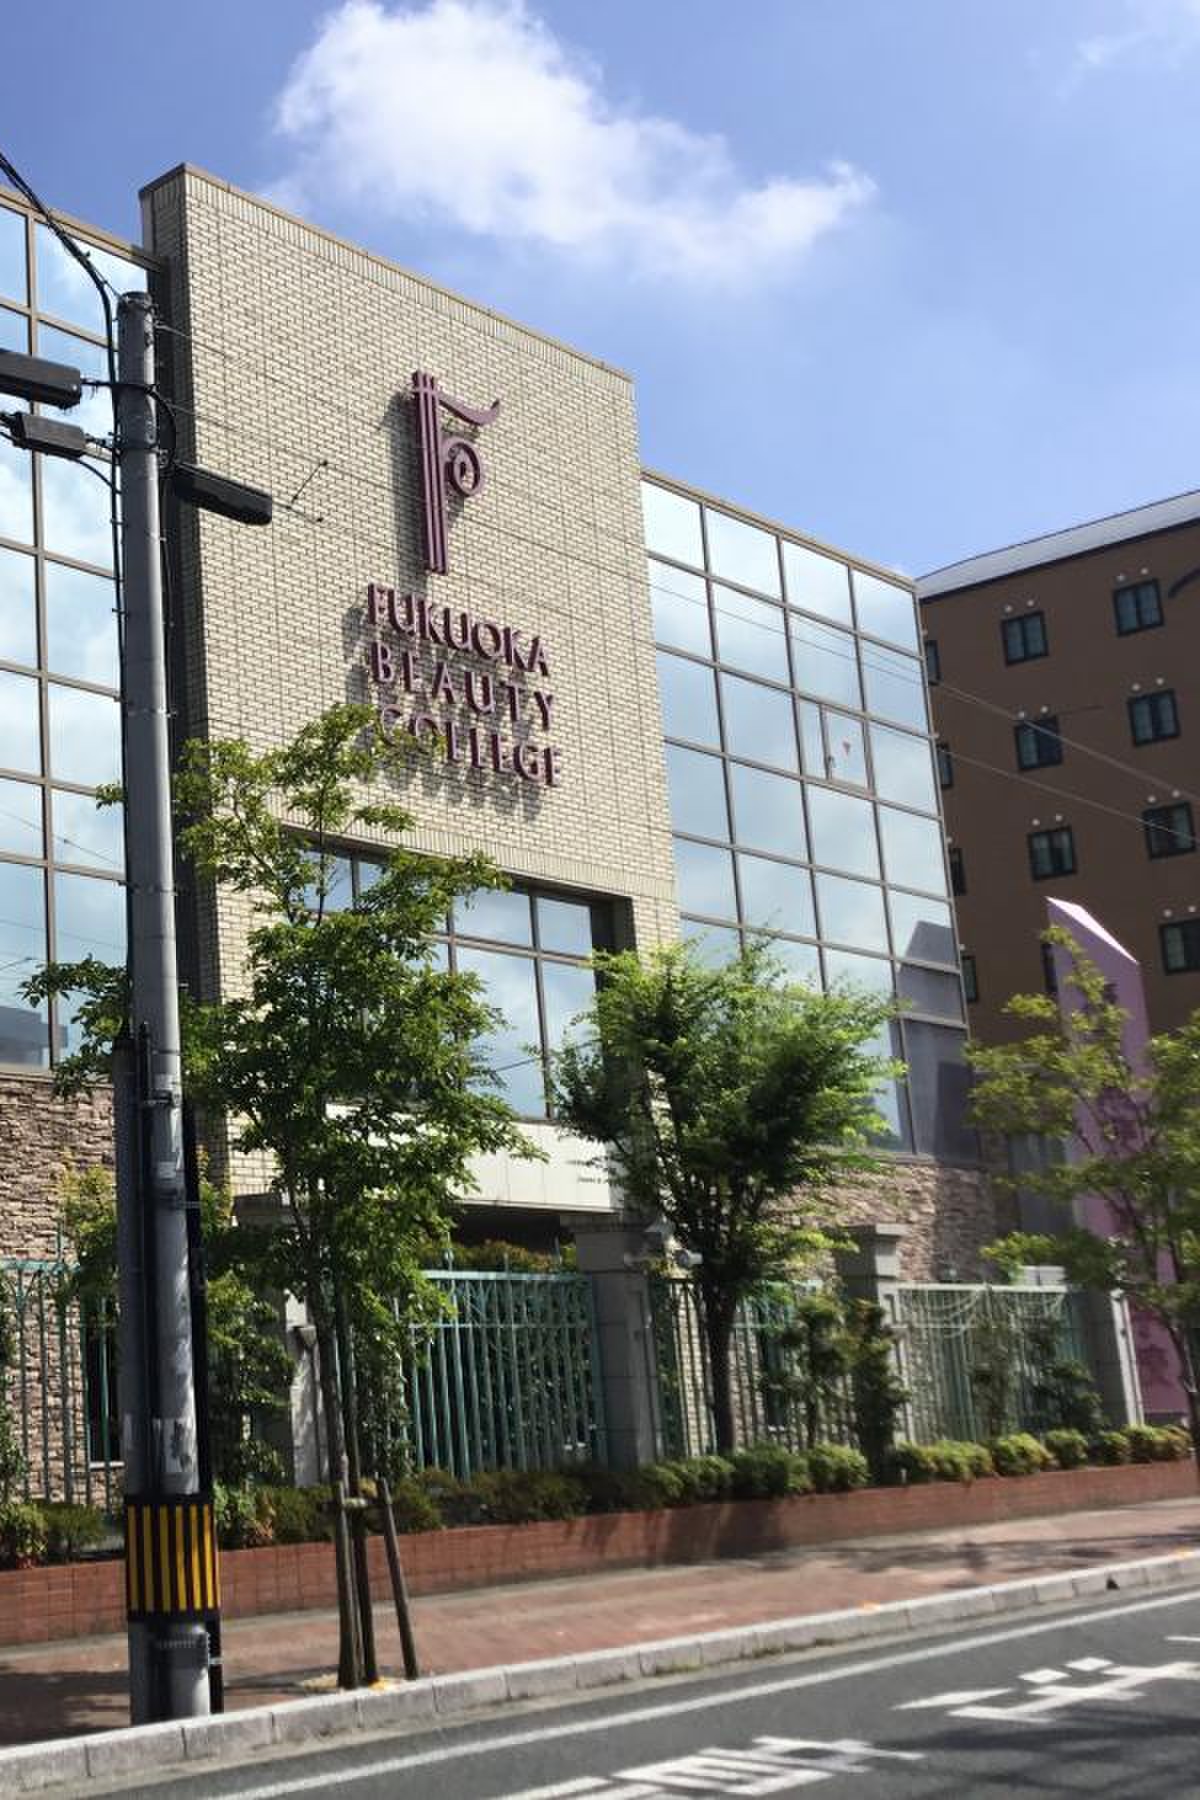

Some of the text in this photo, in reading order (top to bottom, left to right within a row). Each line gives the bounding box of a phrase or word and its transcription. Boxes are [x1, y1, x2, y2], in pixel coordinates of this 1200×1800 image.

[367, 582, 550, 677] FUKUOKA
[369, 640, 554, 731] BEAUTY
[492, 1635, 1200, 1800] 注意
